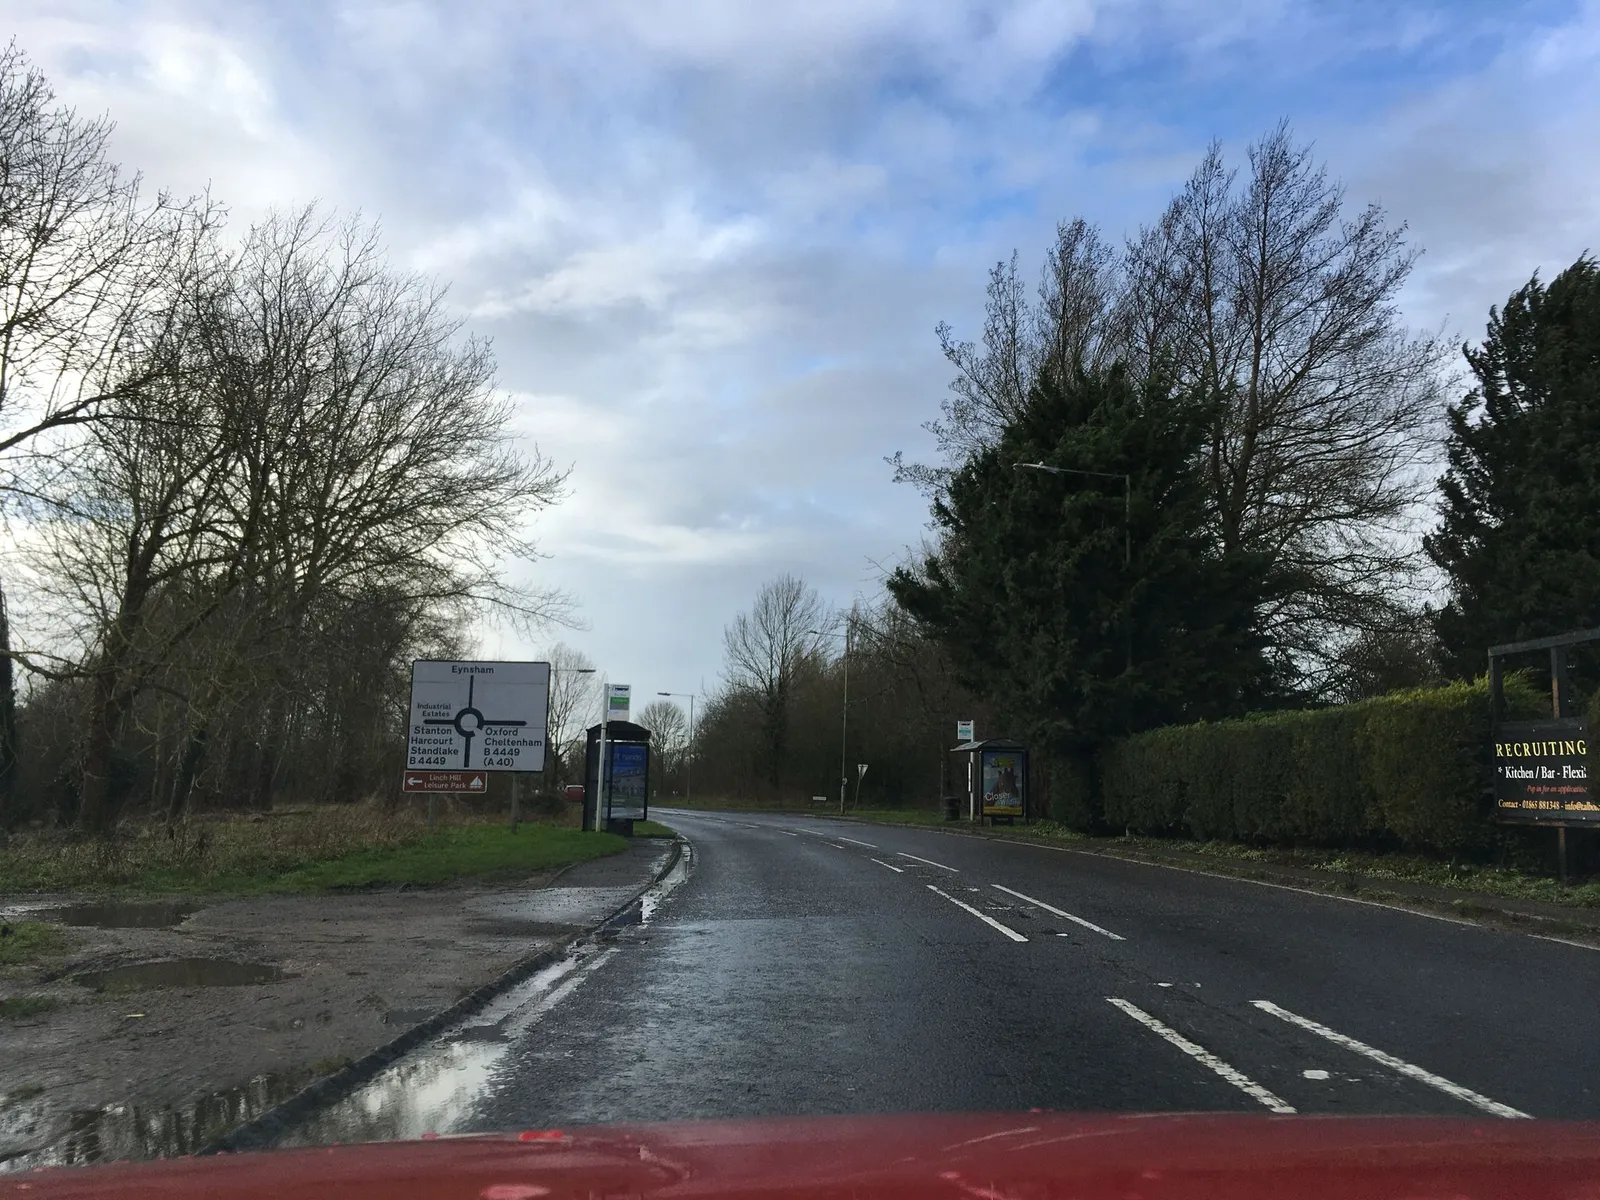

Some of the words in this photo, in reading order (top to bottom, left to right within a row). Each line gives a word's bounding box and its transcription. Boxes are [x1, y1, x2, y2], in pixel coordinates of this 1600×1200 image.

[451, 665, 494, 674] Eynsham
[413, 726, 452, 735] Stanton
[485, 727, 519, 737] Oxford
[411, 737, 453, 745] Harcourt
[484, 738, 543, 747] Cheltenham
[411, 746, 459, 755] Standlake
[1495, 740, 1587, 757] RECRUITING
[1505, 766, 1534, 779] Kitchen
[1541, 766, 1555, 779] Bar
[1498, 798, 1518, 808] Contact
